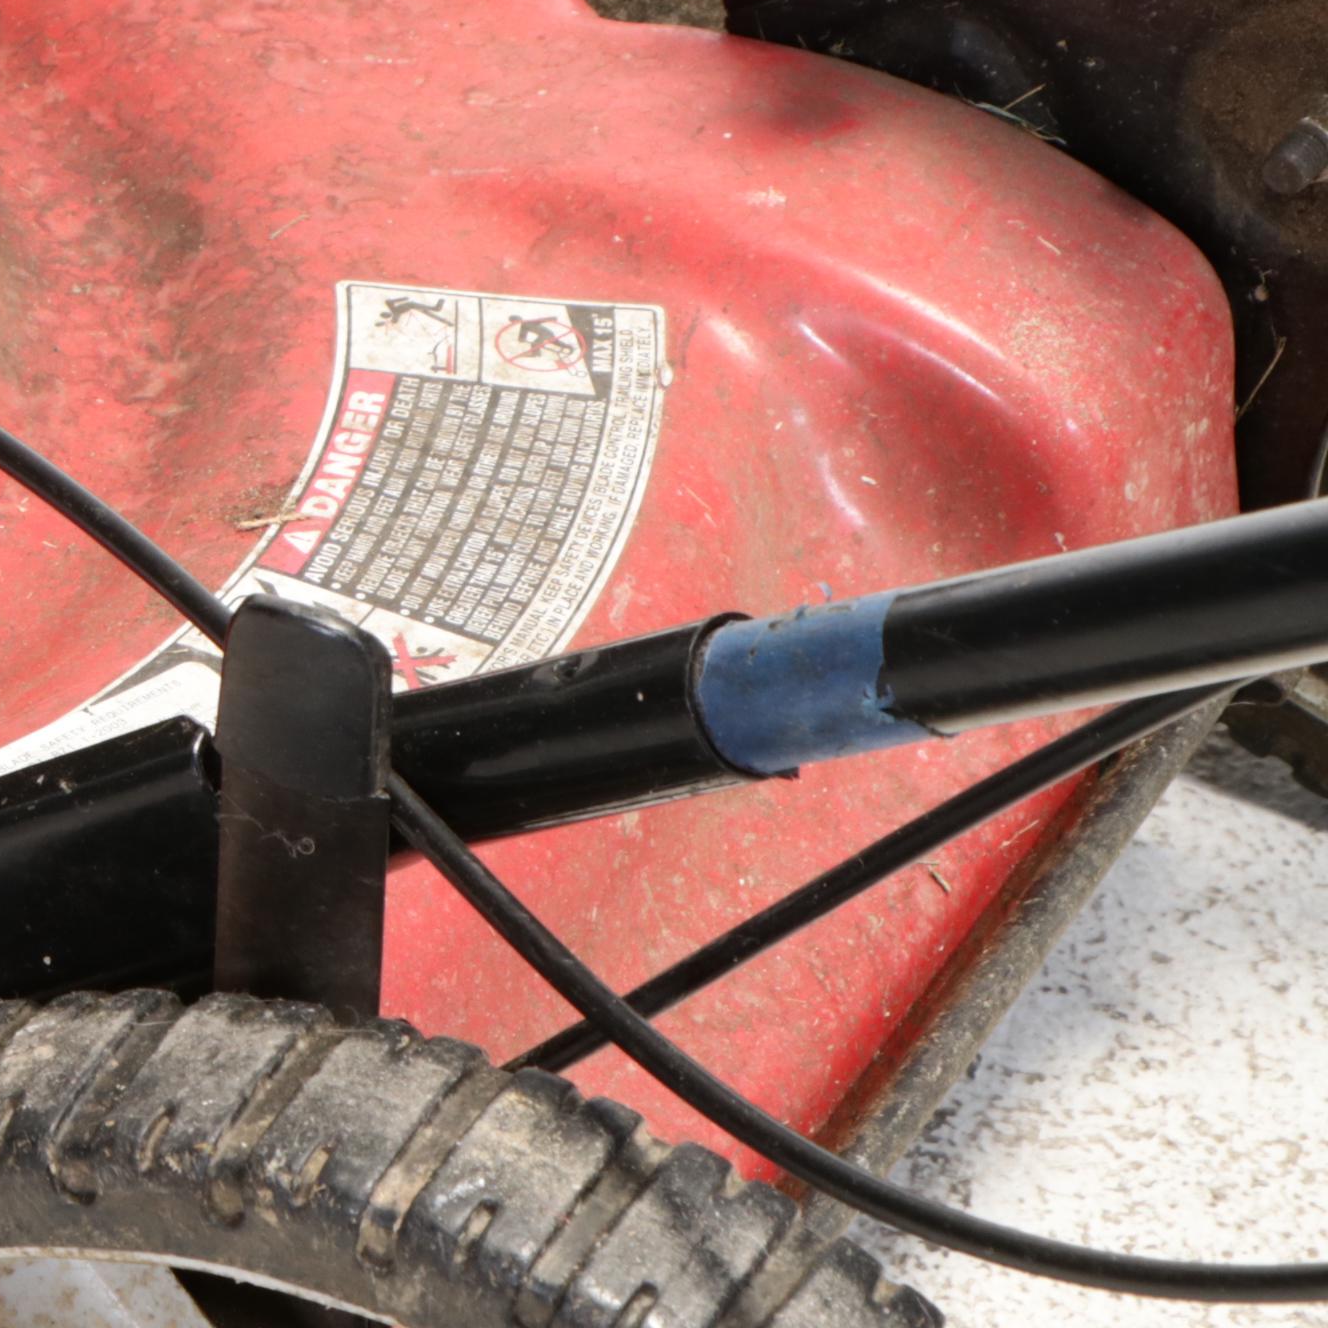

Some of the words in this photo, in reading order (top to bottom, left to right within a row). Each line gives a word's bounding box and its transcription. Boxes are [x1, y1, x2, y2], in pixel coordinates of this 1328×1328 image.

[591, 337, 614, 372] MAX
[619, 329, 635, 365] SHIELD
[389, 376, 421, 418] DEATH
[449, 383, 471, 402] THE
[614, 367, 634, 409] TRAILING
[445, 402, 466, 417] BY
[519, 392, 546, 425] SLOPES
[564, 399, 587, 417] AND
[381, 419, 406, 438] OR
[429, 416, 461, 456] THROWN
[450, 424, 480, 459] SAFETY
[486, 424, 508, 443] ARE
[511, 424, 536, 448] MOW
[537, 421, 559, 441] AND
[557, 416, 582, 443] DOWN
[300, 390, 387, 519] DANGER
[394, 447, 420, 472] FROM
[471, 442, 503, 476] OTHERS
[504, 448, 527, 468] NOT
[532, 439, 553, 454] UP
[548, 443, 574, 467] LOOK
[361, 439, 399, 487] INJURY
[424, 456, 445, 470] BE
[438, 458, 466, 486] WEAR
[498, 466, 519, 481] DO
[520, 453, 549, 483] NEVER
[382, 471, 409, 497] AWAY
[415, 469, 440, 490] CAN
[466, 474, 489, 489] OR
[559, 463, 591, 506] MOVING
[328, 486, 376, 542] SERIOUS
[372, 495, 398, 516] FEET
[402, 489, 431, 515] THAT
[447, 487, 482, 531] CHILDREN
[531, 489, 557, 514] YOUR
[546, 606, 562, 628] IN
[554, 583, 583, 618] PLACE
[578, 562, 594, 583] AND
[627, 394, 648, 440] REPLACE
[362, 514, 387, 534] AND
[526, 512, 547, 526] TO
[544, 505, 575, 539] WHILE
[575, 497, 603, 538] DEVICES
[380, 513, 418, 555] OBJECTS
[433, 528, 463, 555] WHEN
[492, 519, 520, 544] MOW
[511, 525, 541, 554] CLOSE
[344, 532, 377, 563] HANDS
[401, 537, 427, 559] ANY
[453, 530, 490, 570] CAUTION
[533, 540, 559, 563] AND
[559, 540, 583, 578] SAFETY
[303, 541, 343, 583] AVOID
[332, 559, 359, 583] KEEP
[356, 553, 395, 593] REMOVE
[395, 556, 416, 569] IN
[420, 554, 448, 578] MOW
[469, 560, 499, 586] THAN
[495, 551, 527, 585] MOWER
[377, 567, 410, 599] BLADE
[409, 575, 434, 596] NOT
[437, 568, 470, 599] EXTRA
[509, 561, 548, 601] BEFORE
[543, 579, 563, 604] KEEP
[400, 593, 424, 610] DO
[425, 596, 451, 617] USE
[444, 584, 484, 625] GREATER
[482, 583, 510, 607] PULL
[463, 605, 496, 634] NEVER
[483, 601, 523, 640] BEHIND
[40, 725, 86, 757] SAFETY
[91, 678, 182, 727] REQUIREMENTS
